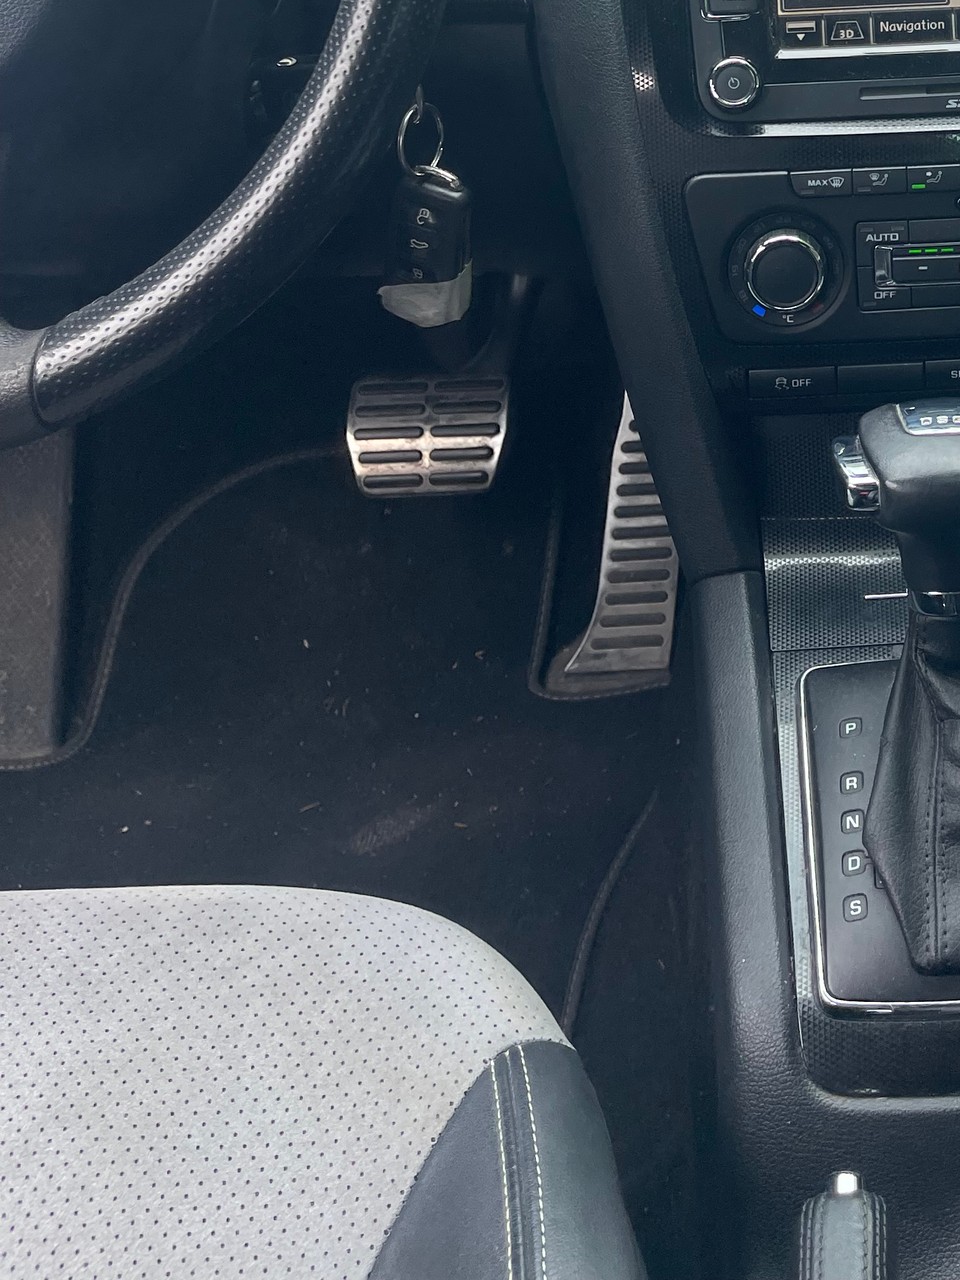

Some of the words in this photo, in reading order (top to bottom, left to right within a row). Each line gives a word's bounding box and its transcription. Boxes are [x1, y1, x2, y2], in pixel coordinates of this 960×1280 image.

[879, 19, 945, 34] Navigation
[839, 29, 855, 39] 3D
[807, 179, 828, 187] MAX
[865, 232, 899, 242] AUTO
[873, 290, 897, 300] OFF
[791, 378, 812, 388] OFF
[845, 723, 856, 734] P
[845, 777, 857, 790] R
[846, 814, 860, 829] N
[848, 855, 861, 871] D
[849, 899, 862, 915] S
